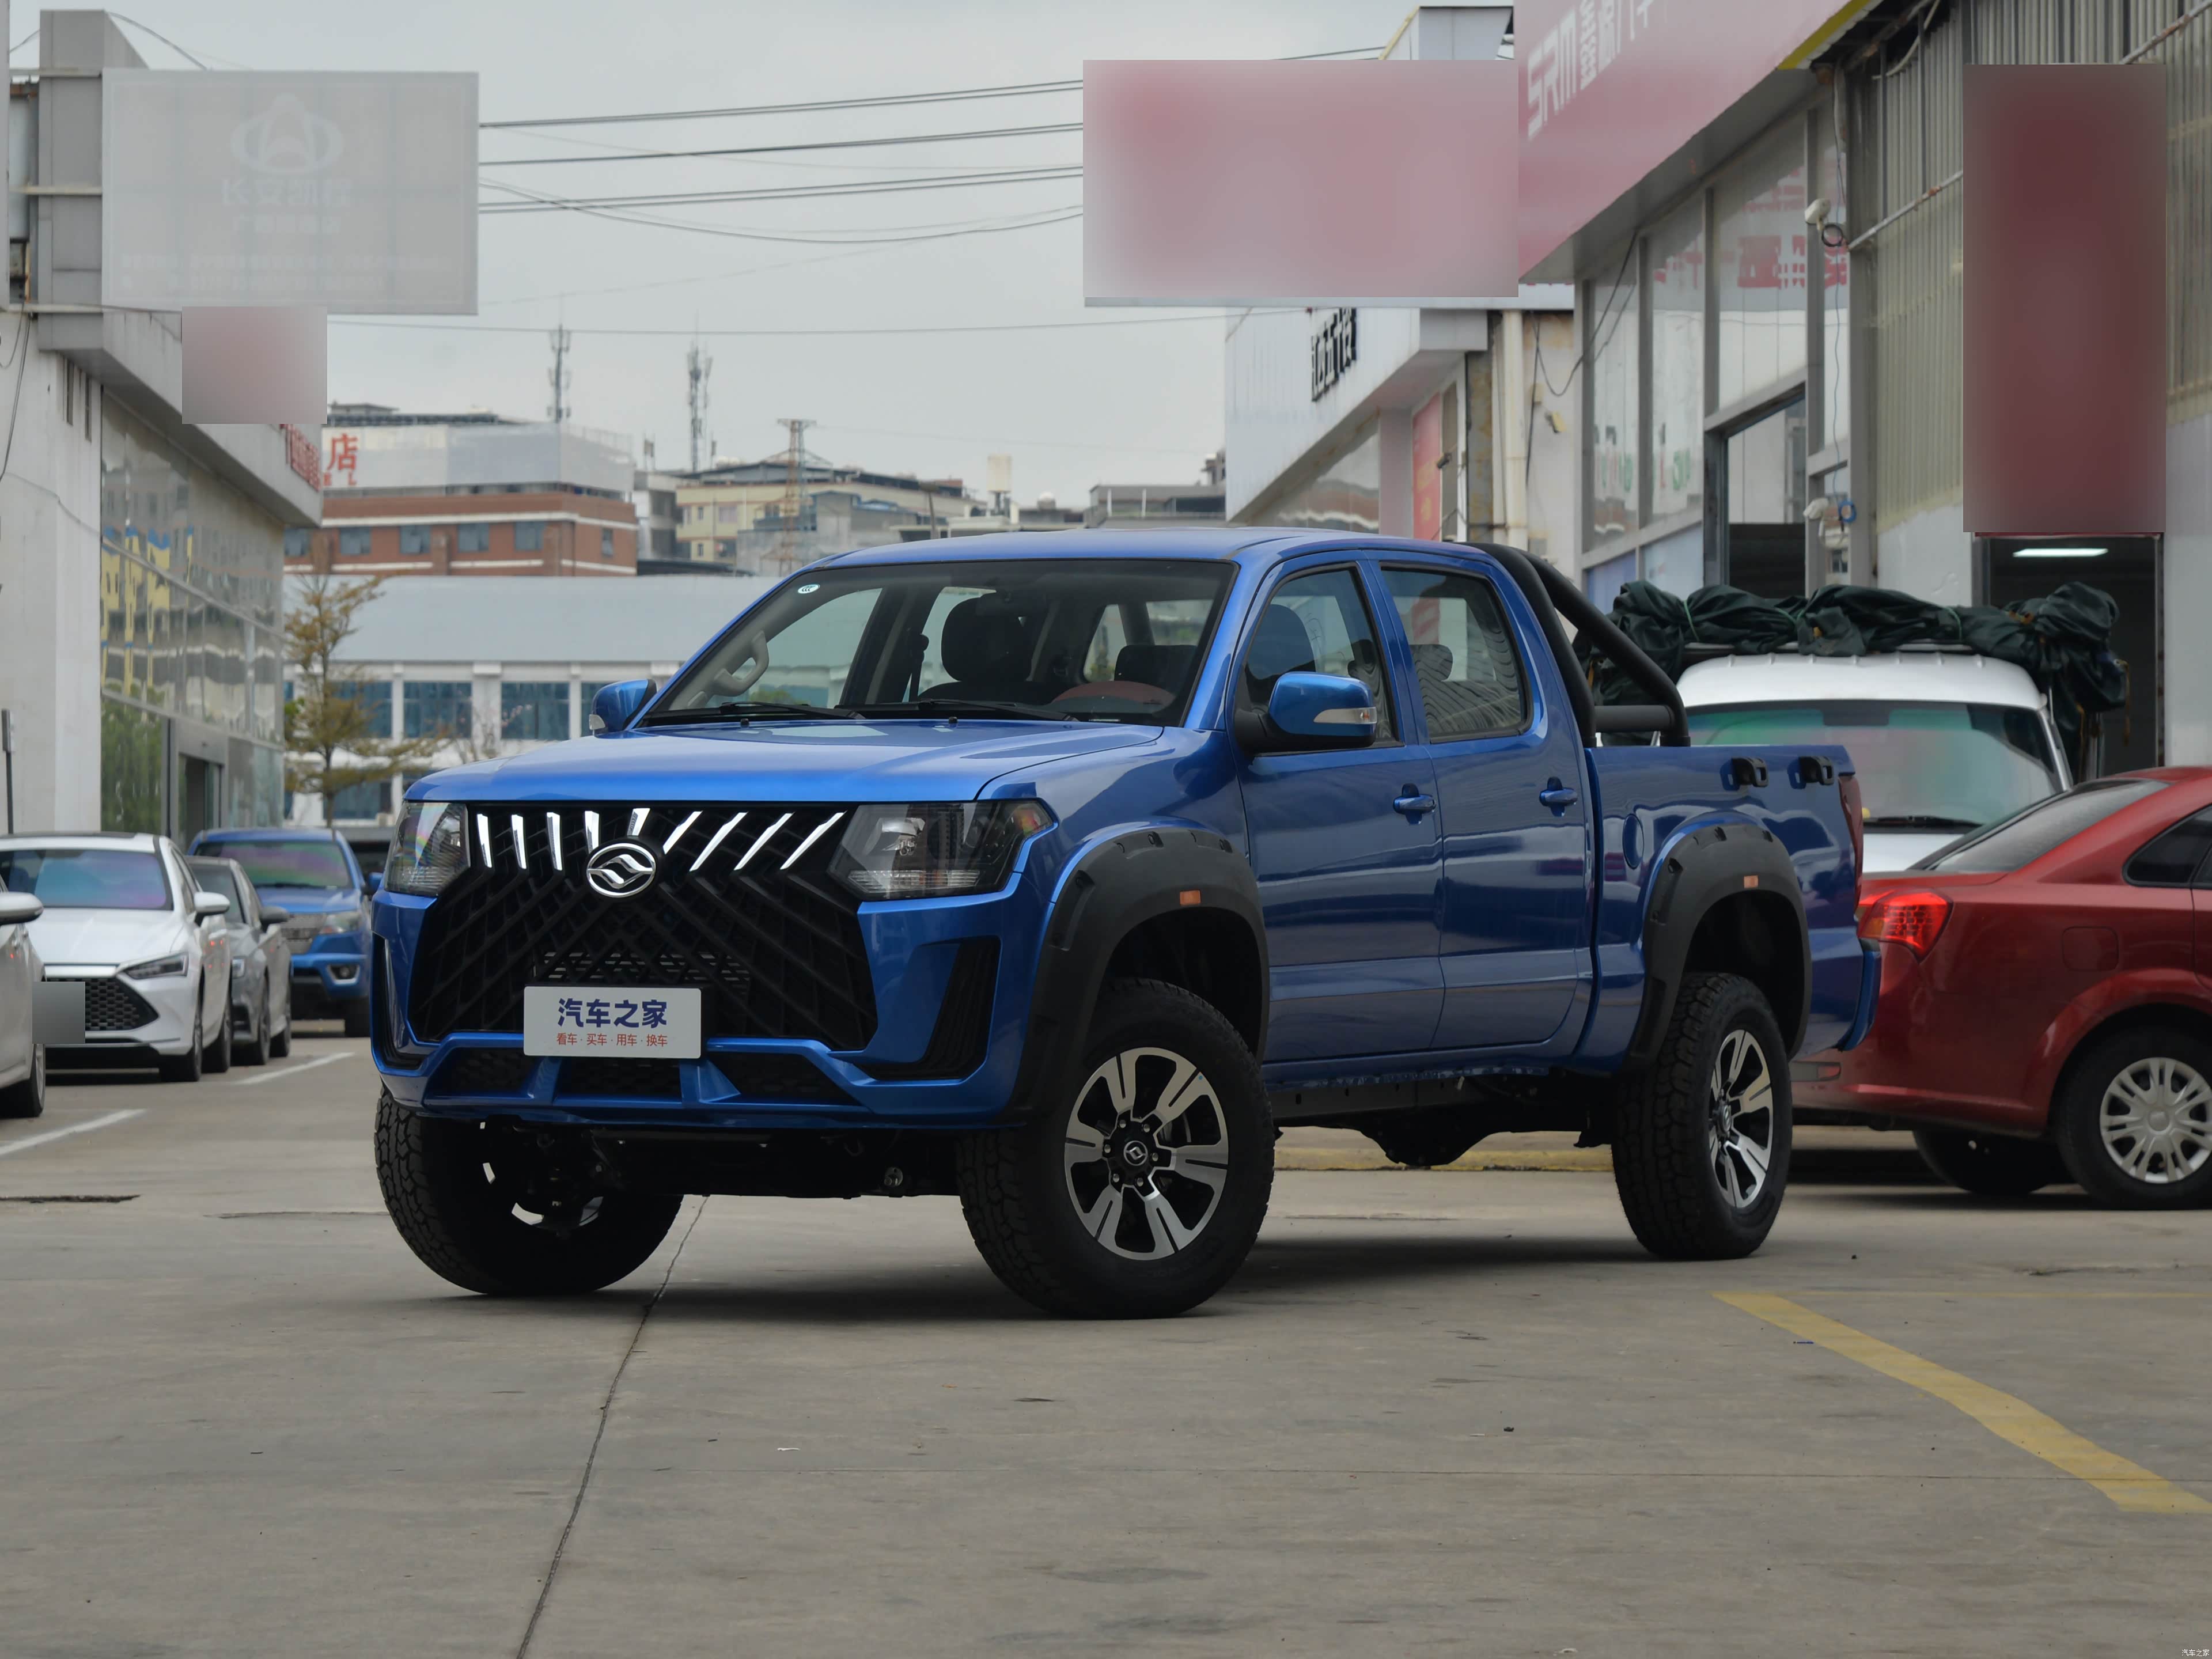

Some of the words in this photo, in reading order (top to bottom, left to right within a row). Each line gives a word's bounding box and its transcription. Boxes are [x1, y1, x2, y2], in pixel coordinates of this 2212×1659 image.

[1528, 7, 1577, 141] SRM
[327, 433, 358, 469] 店
[558, 998, 667, 1029] 汽车之家
